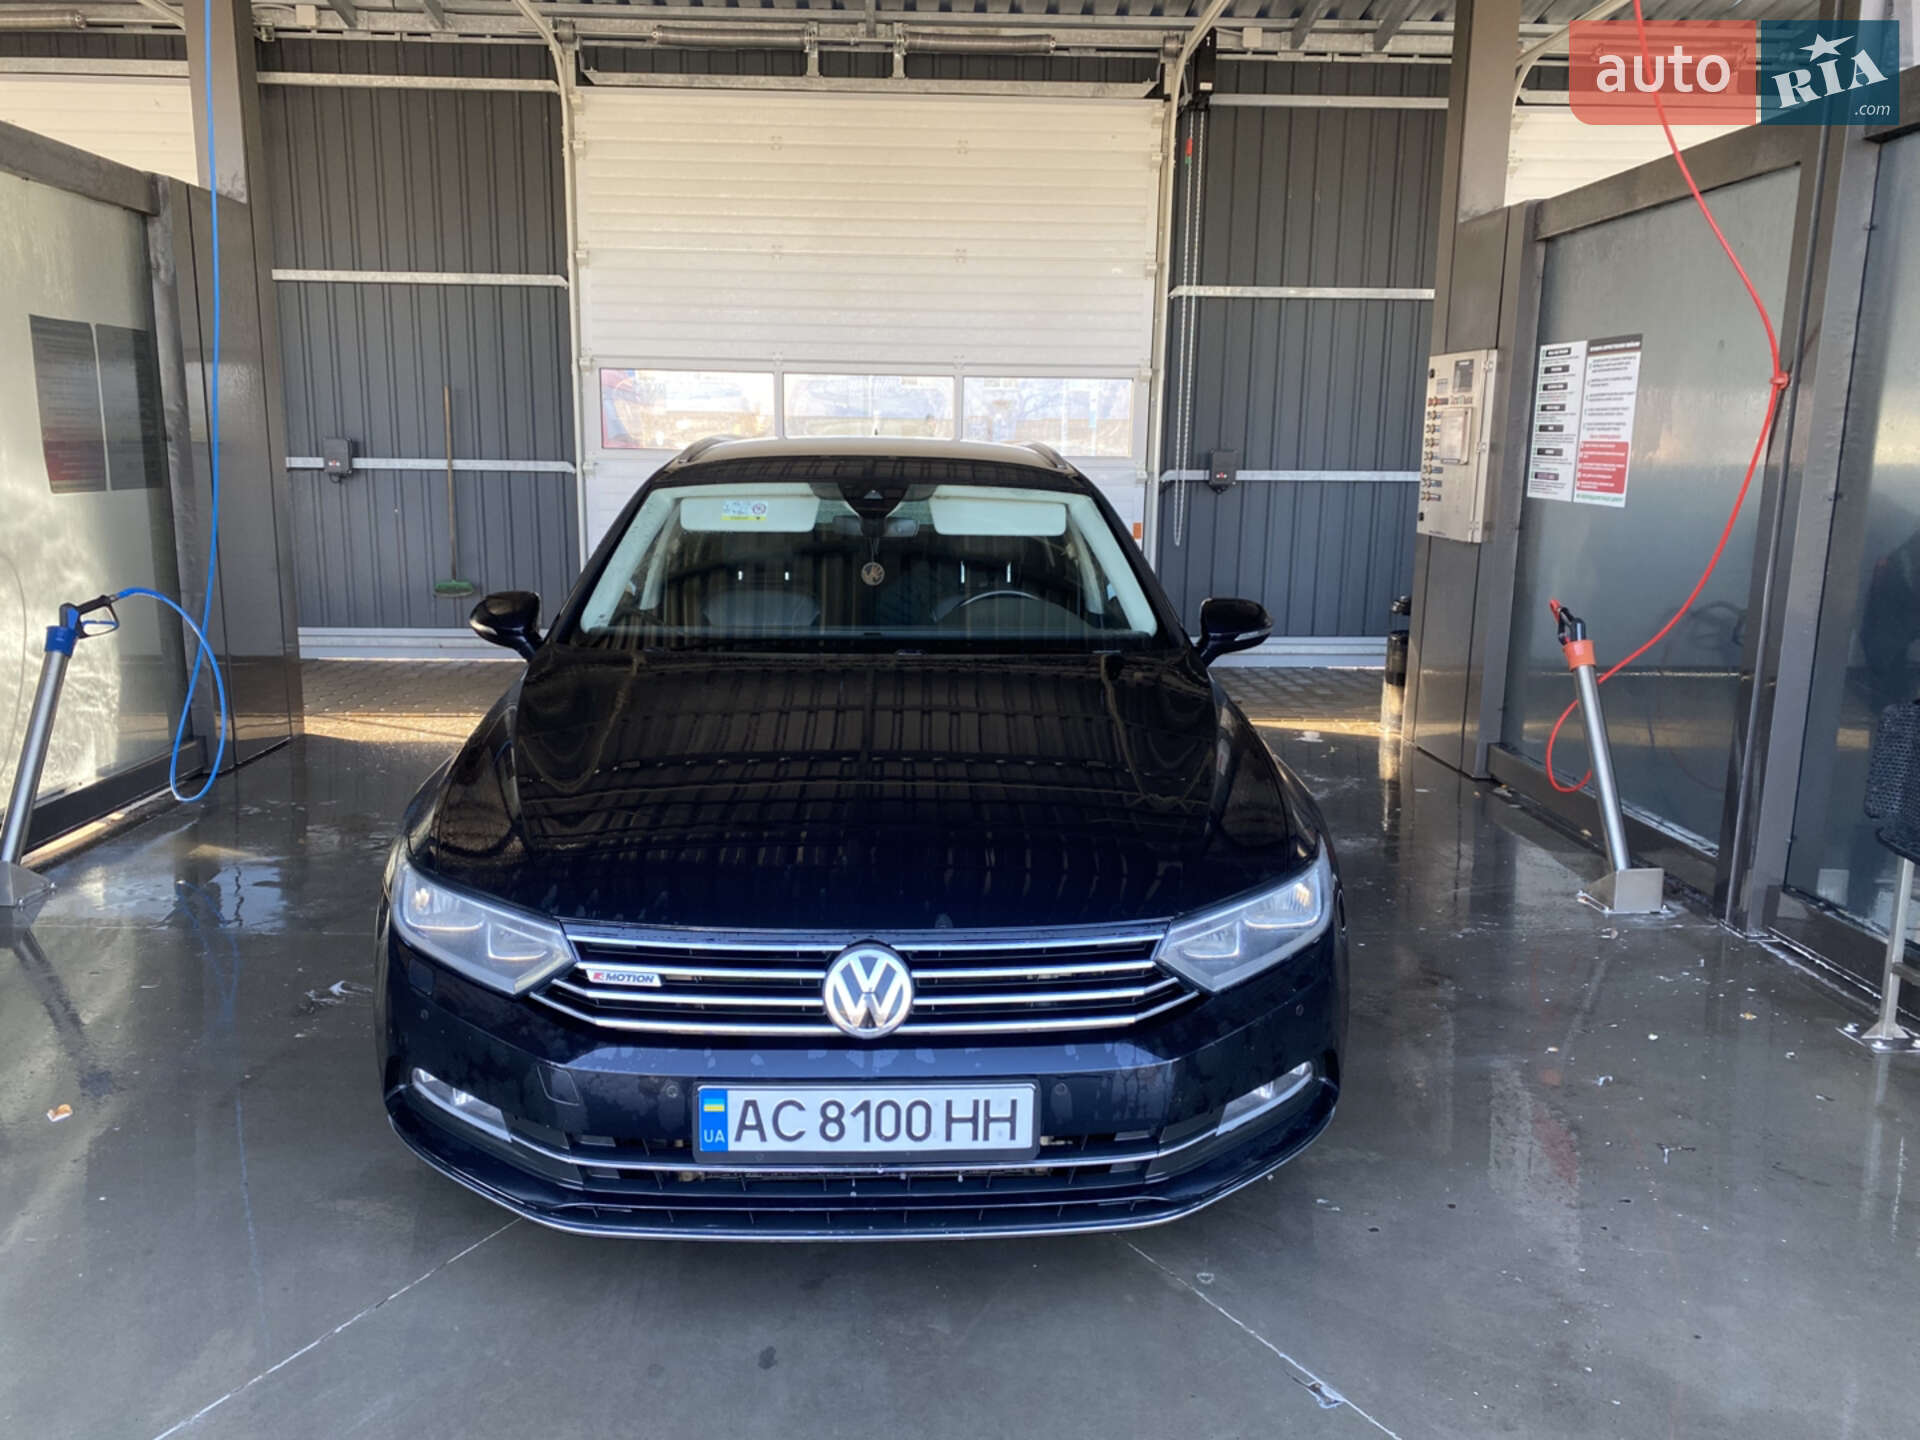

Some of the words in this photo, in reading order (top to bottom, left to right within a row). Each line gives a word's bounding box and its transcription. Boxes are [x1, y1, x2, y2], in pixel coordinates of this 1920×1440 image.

[734, 1099, 806, 1143] AC
[818, 1099, 932, 1143] 8100
[945, 1098, 1018, 1142] HH
[703, 1130, 726, 1143] UA
